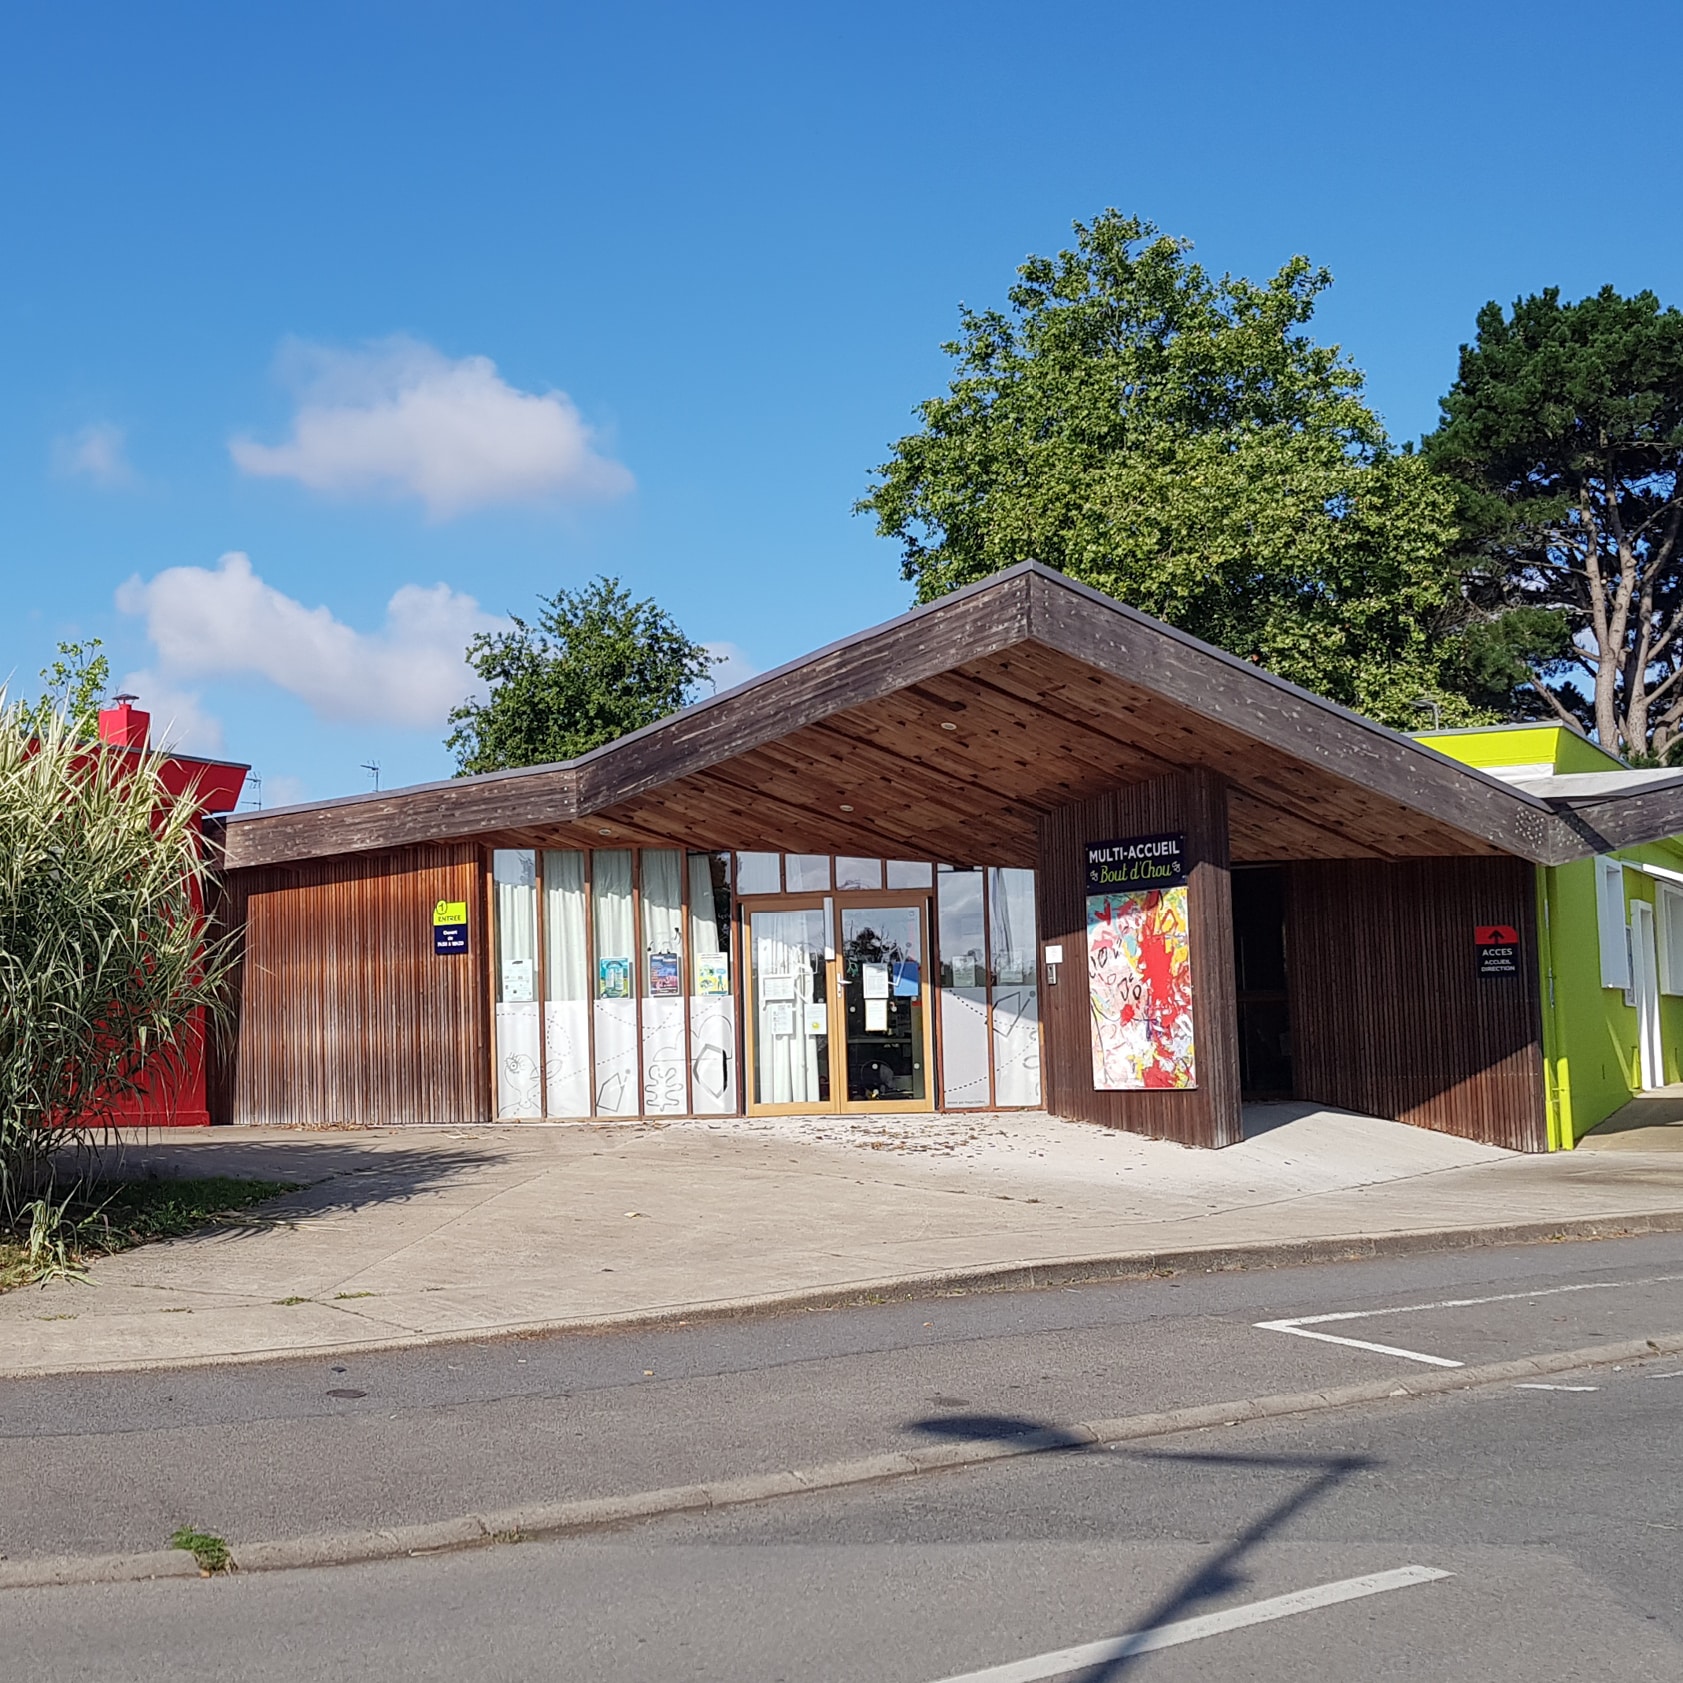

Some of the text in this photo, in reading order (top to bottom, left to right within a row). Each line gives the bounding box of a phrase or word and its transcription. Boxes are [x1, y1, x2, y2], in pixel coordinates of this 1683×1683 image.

[1089, 840, 1181, 864] MULTI-ACCUEIL
[1099, 859, 1173, 884] Bout d'Chou
[1482, 948, 1512, 956] ACCES
